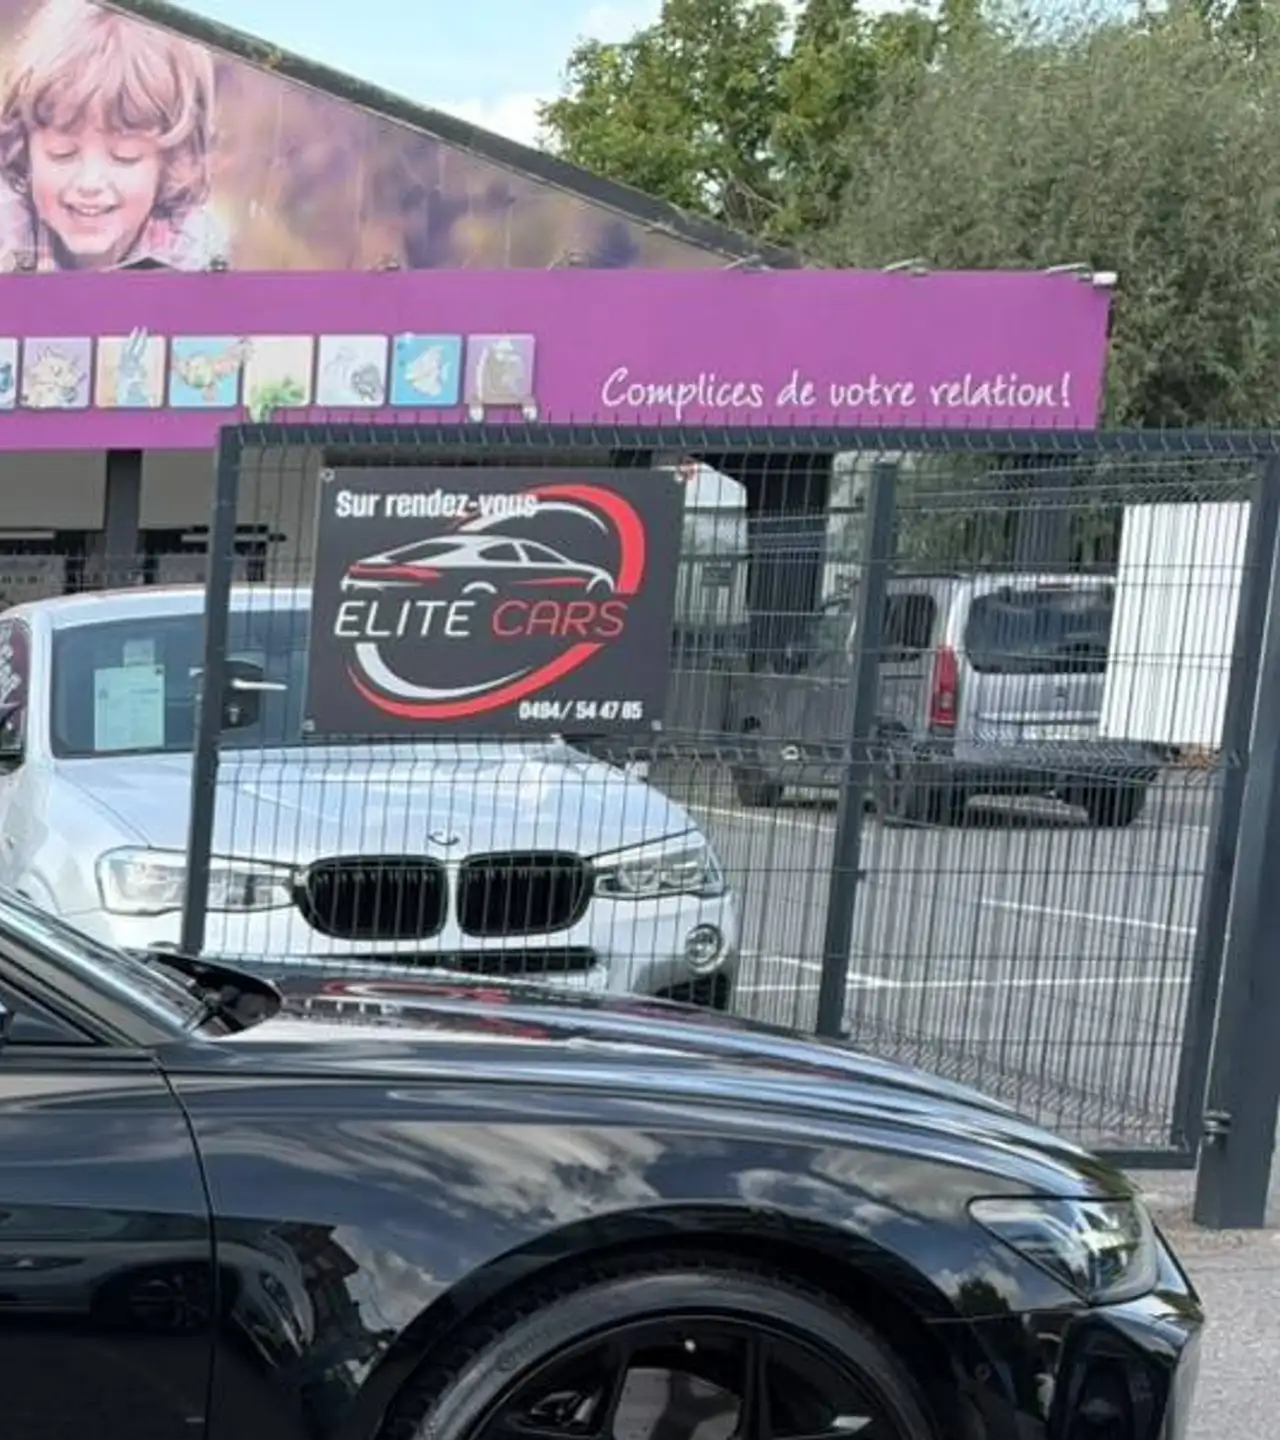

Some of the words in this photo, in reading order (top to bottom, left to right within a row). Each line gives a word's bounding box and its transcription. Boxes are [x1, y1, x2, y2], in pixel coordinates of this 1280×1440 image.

[601, 366, 764, 420] Complices
[777, 369, 816, 408] de
[830, 382, 916, 408] votre
[929, 372, 1072, 408] relation!
[335, 489, 377, 518] Sur
[385, 488, 539, 519] rendez-vous
[333, 600, 476, 637] ELITE
[491, 600, 628, 637] CARS
